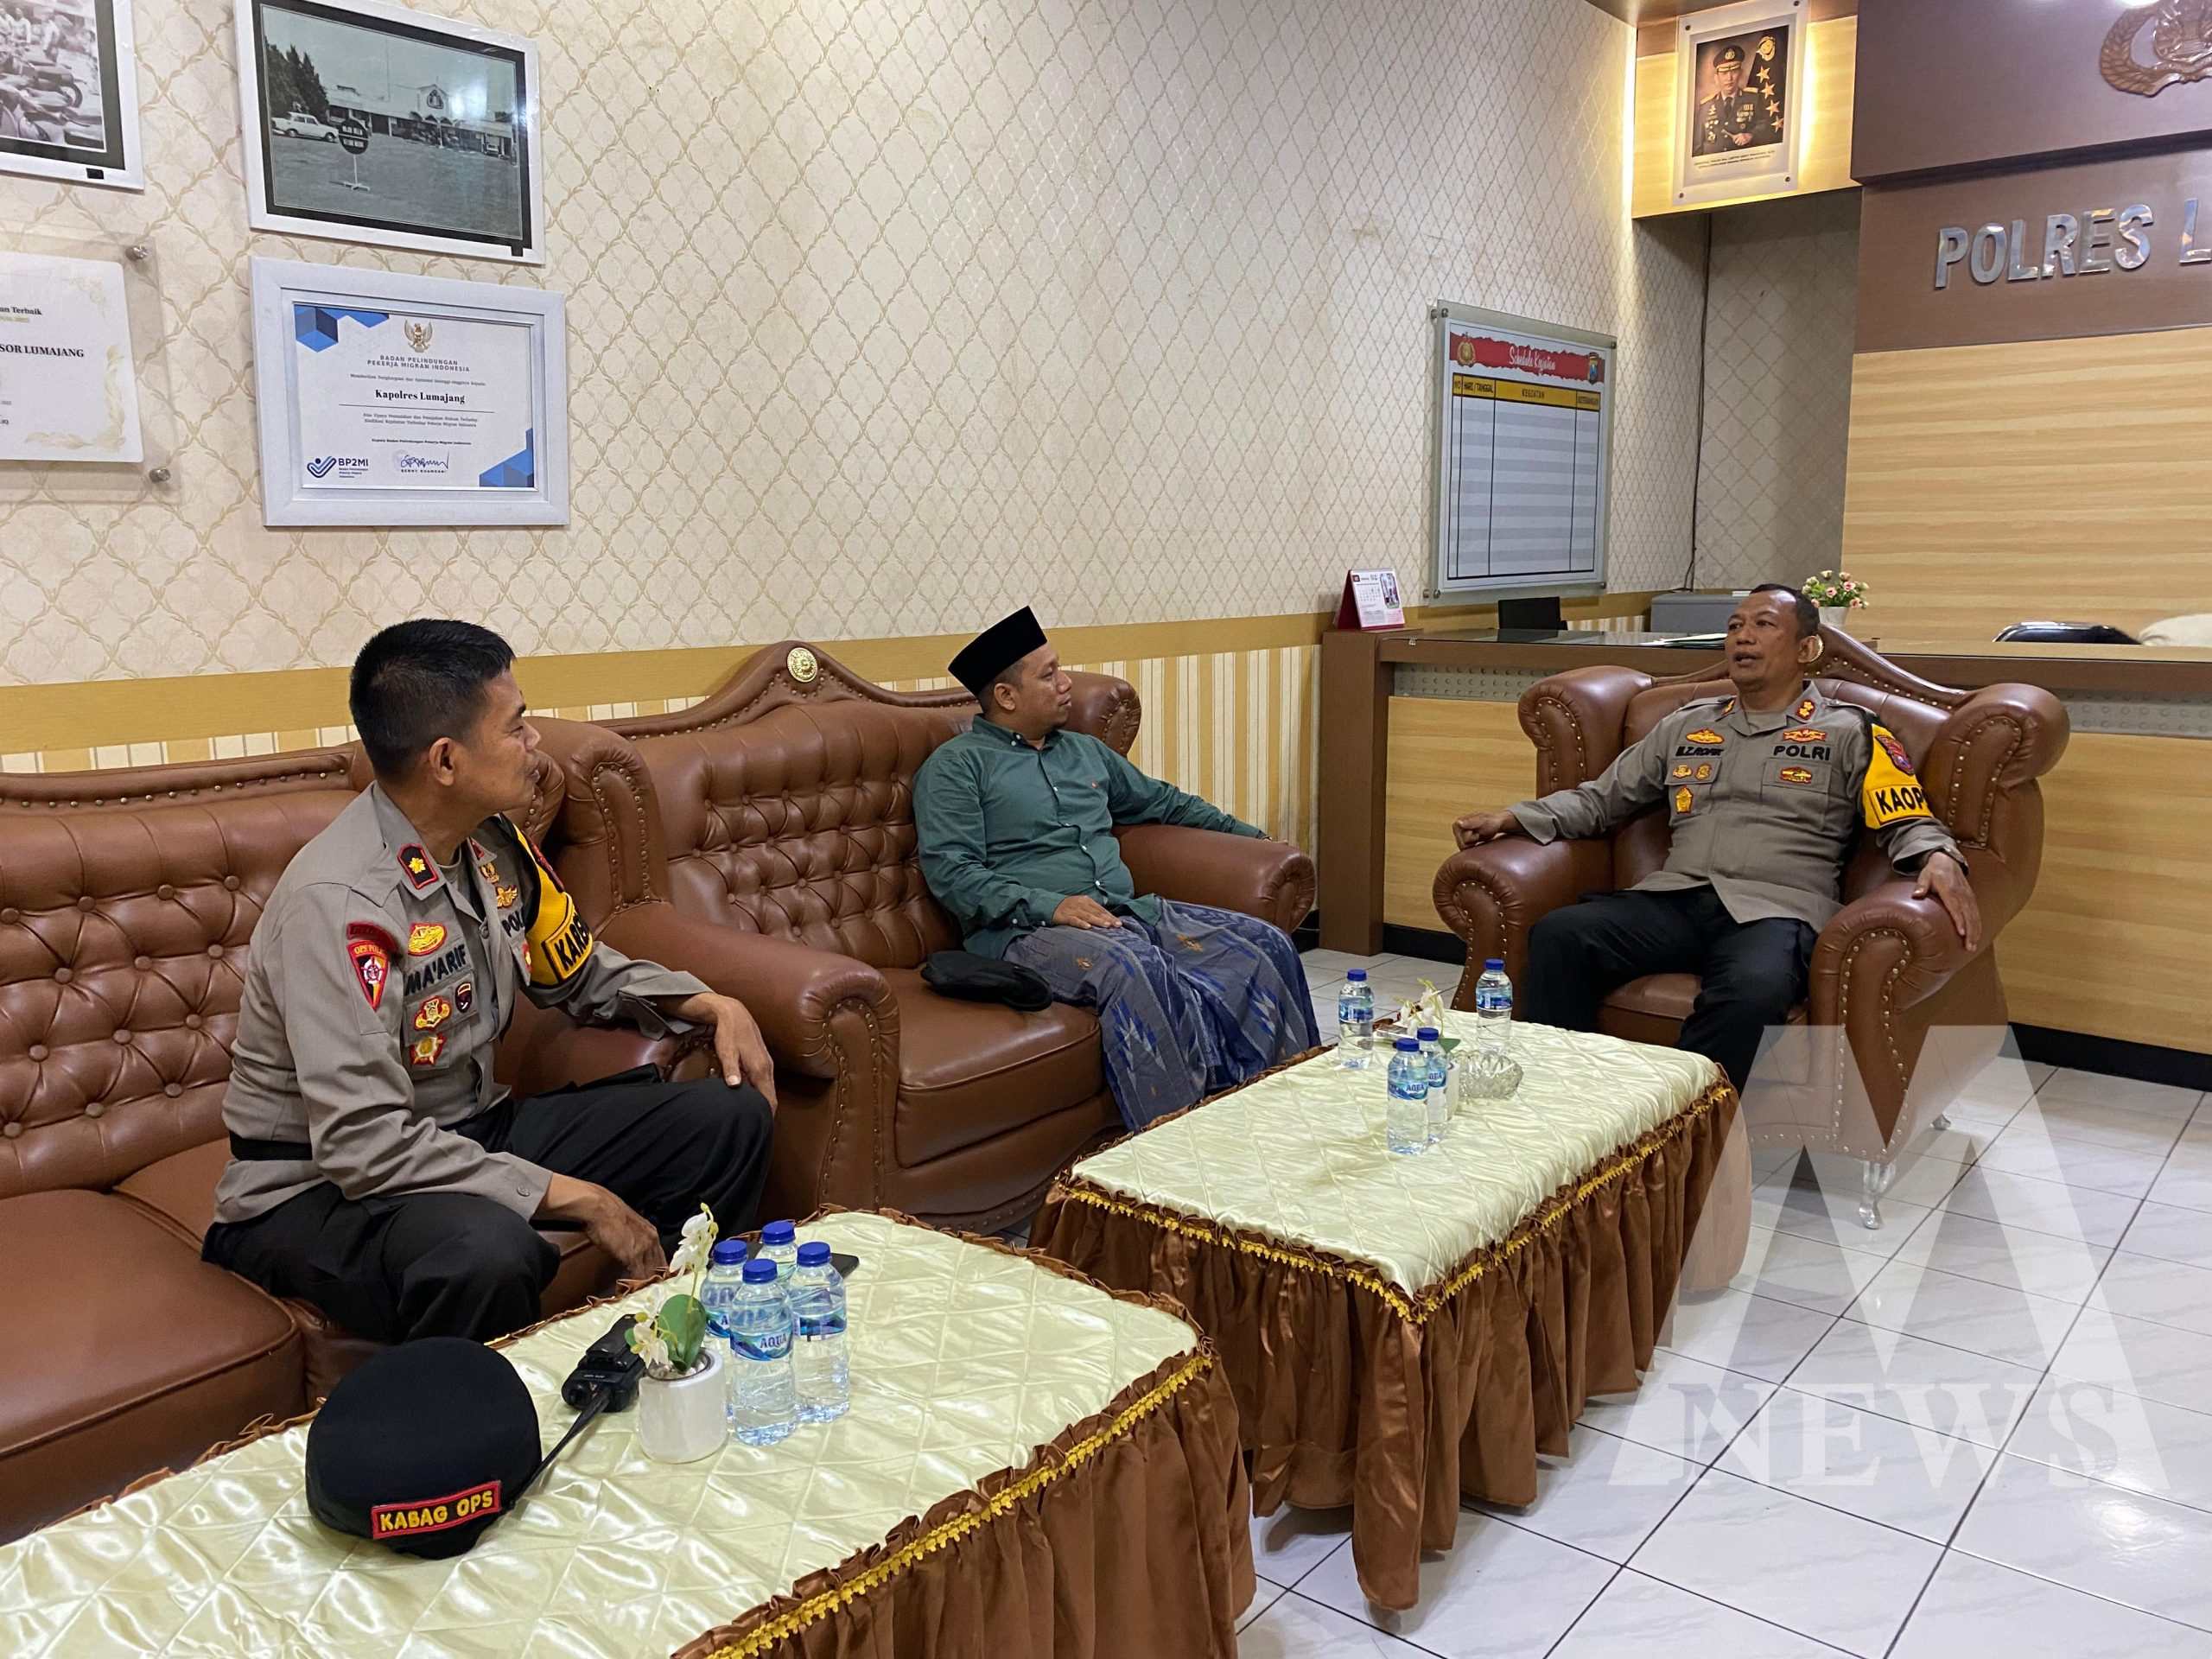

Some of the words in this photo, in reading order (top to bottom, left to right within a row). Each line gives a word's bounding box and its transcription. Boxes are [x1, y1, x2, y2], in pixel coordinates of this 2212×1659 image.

[1935, 204, 2154, 289] POLRES
[24, 346, 85, 358] LUMAJANG
[408, 357, 458, 365] PELINDUNGAN
[375, 390, 418, 401] Kapolres
[420, 391, 465, 404] Lumajang
[339, 458, 368, 467] BP2MI
[1773, 745, 1831, 761] POLRI
[760, 1332, 788, 1349] AQUA
[380, 1505, 448, 1532] KABAG
[456, 1490, 493, 1517] OPS
